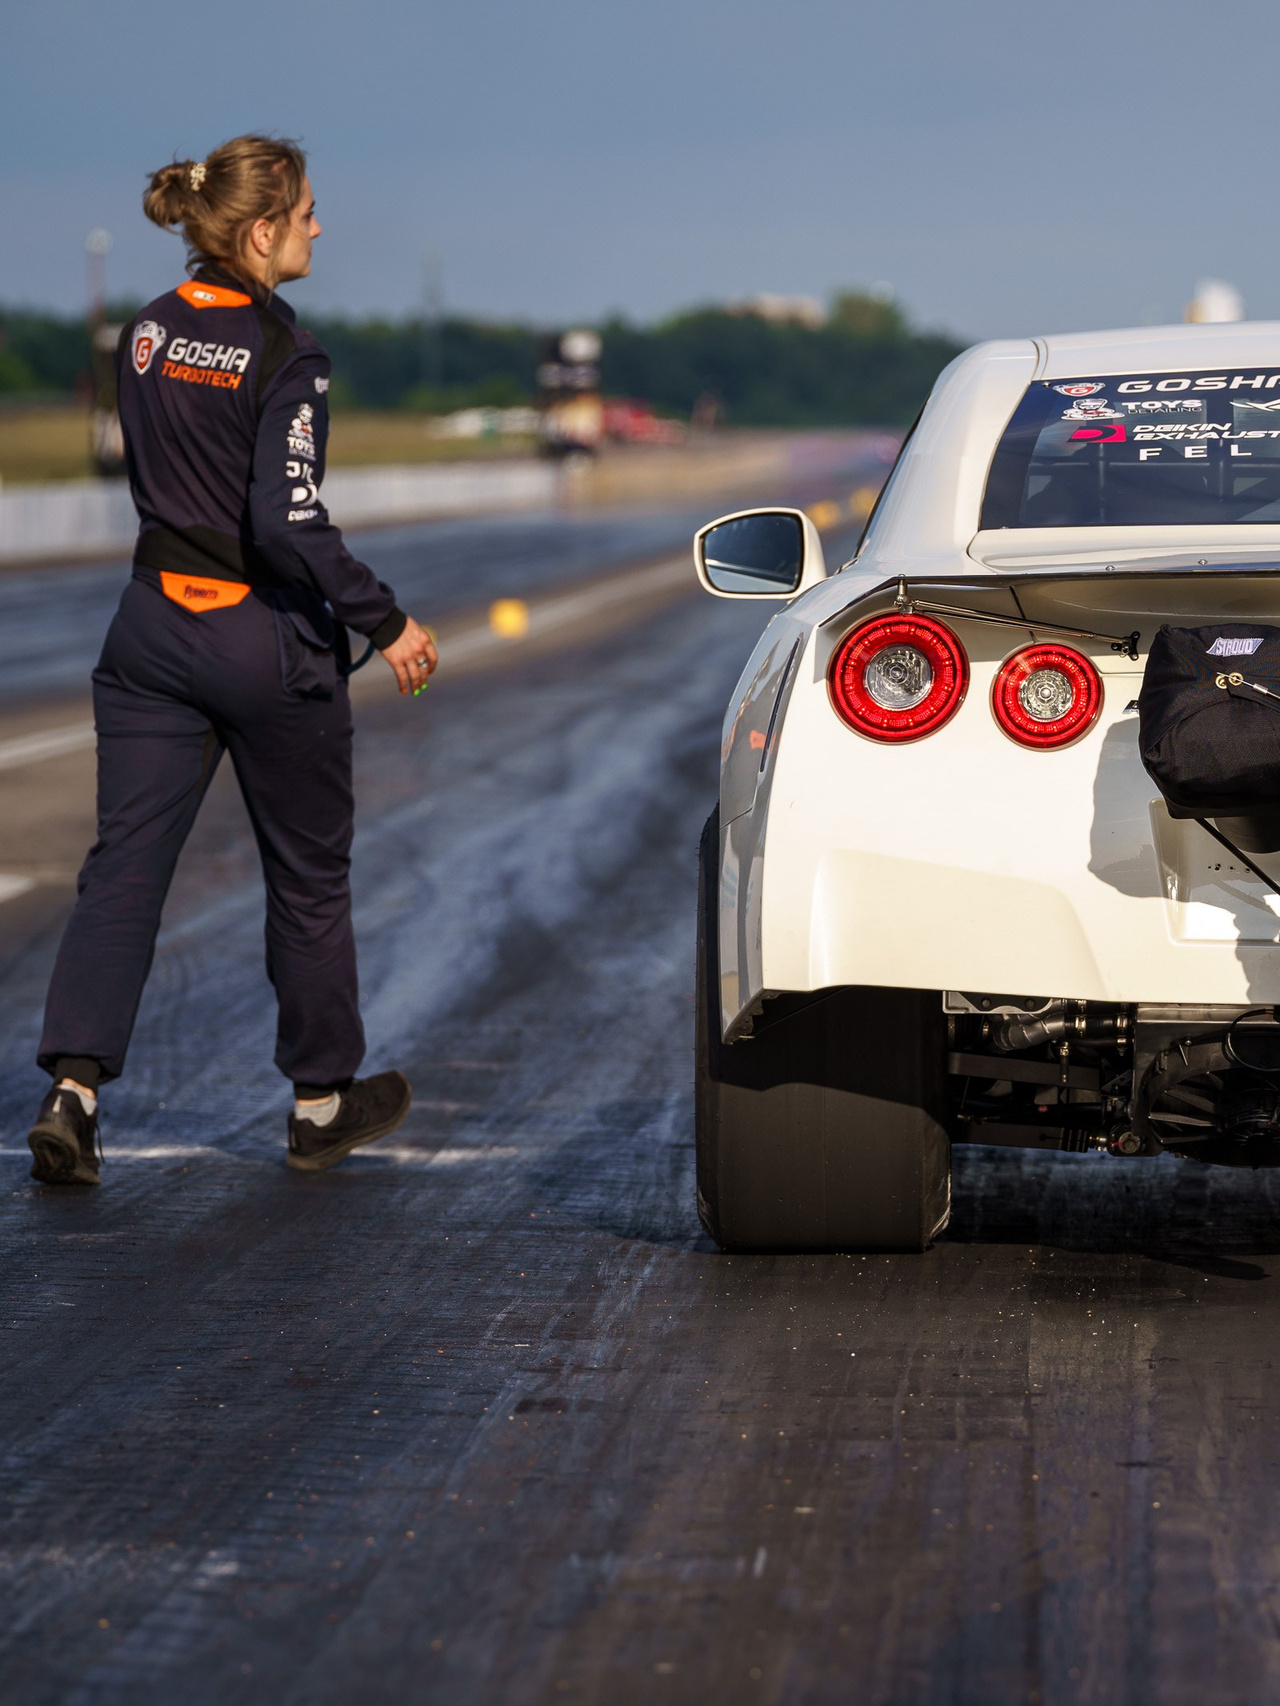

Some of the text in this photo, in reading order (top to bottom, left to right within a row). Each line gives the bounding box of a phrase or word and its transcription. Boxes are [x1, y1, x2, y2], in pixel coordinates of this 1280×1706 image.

[167, 337, 251, 373] GOSHA
[161, 361, 242, 389] TURBOTECH
[1121, 399, 1203, 410] TOYS
[1128, 406, 1203, 414] DETAILING
[1216, 639, 1254, 657] STROUD
